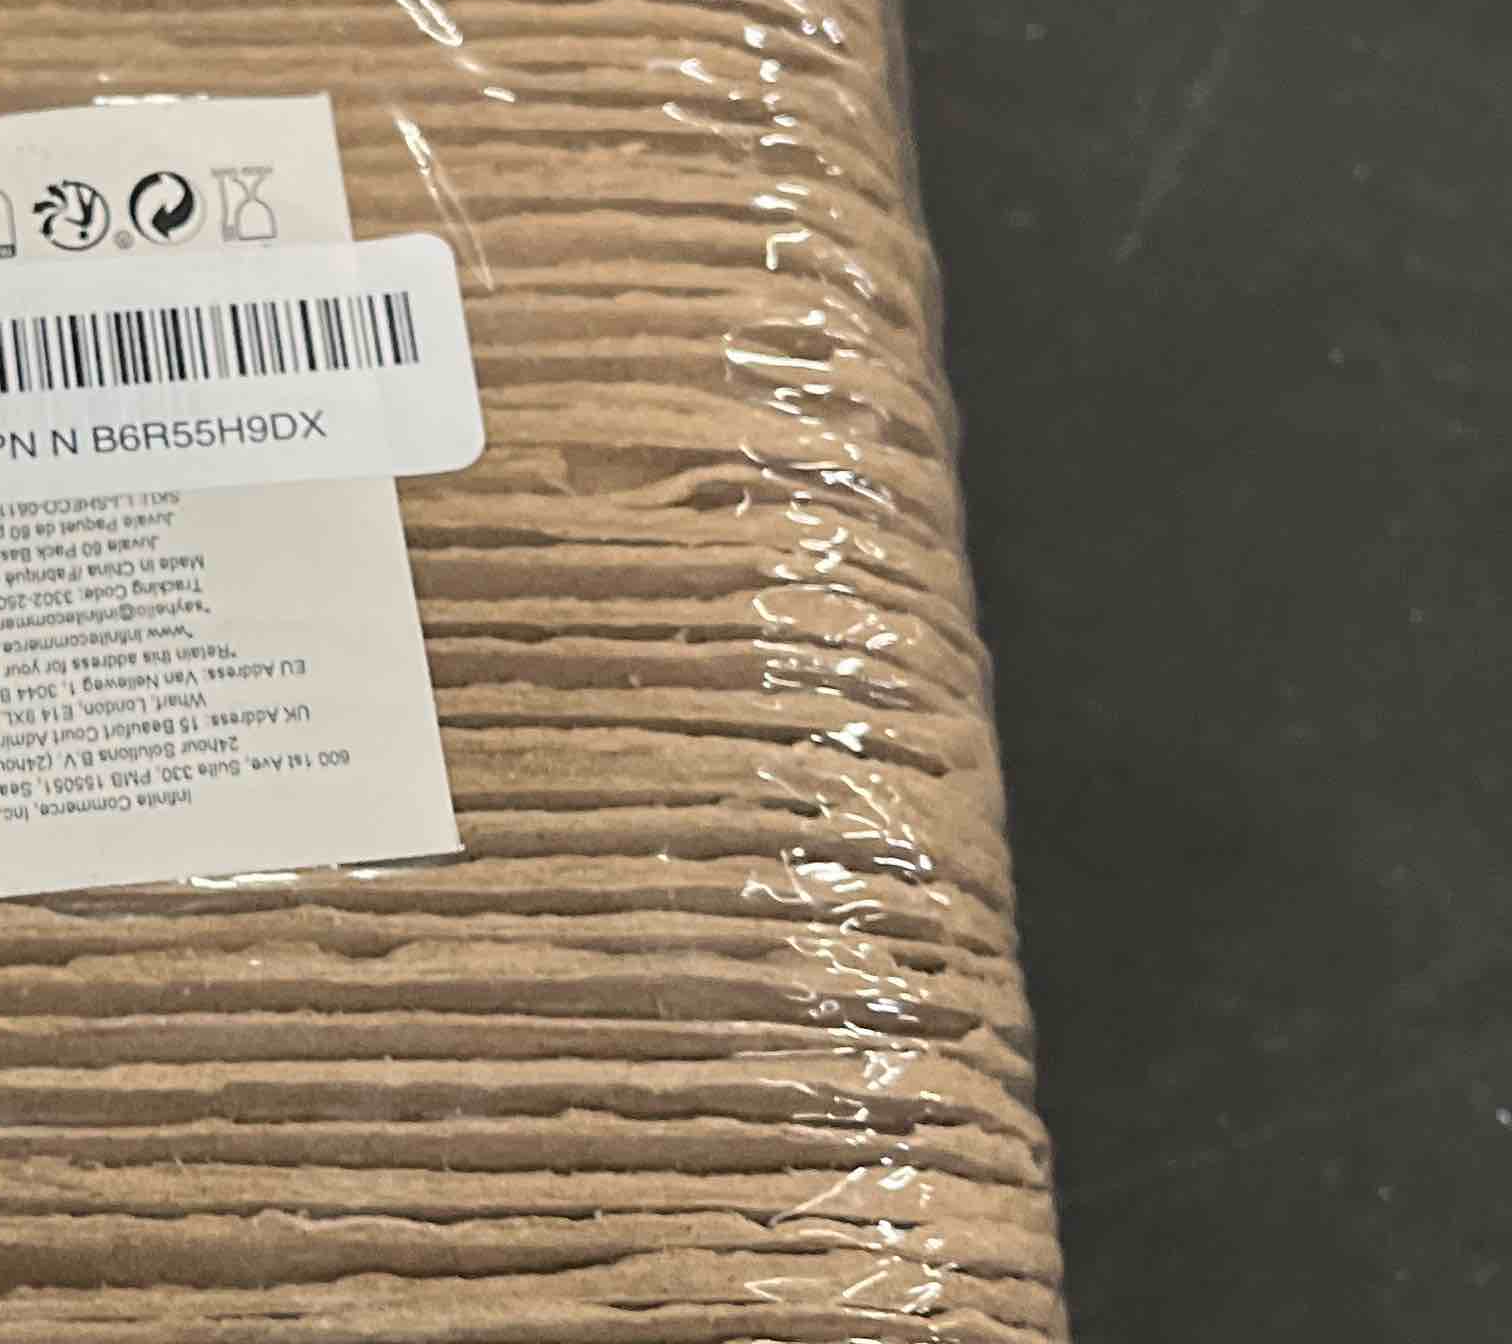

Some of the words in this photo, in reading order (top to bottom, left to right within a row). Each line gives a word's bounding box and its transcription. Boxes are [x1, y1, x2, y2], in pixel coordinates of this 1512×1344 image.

[51, 428, 79, 457] N
[91, 409, 328, 454] B6R55H9DX
[33, 519, 57, 539] de
[58, 515, 119, 537] Paquet
[121, 511, 176, 531] Juvale
[34, 541, 78, 563] Pack
[105, 533, 161, 555] Juvale
[85, 559, 136, 580] China
[138, 557, 156, 575] in
[157, 553, 206, 574] Made
[77, 583, 129, 604] Code:
[130, 574, 204, 598] Tracking
[3, 657, 41, 679] your
[44, 657, 68, 677] for
[70, 651, 138, 672] address
[141, 648, 173, 667] this
[279, 658, 307, 678] EU
[161, 668, 200, 688] Van
[201, 659, 276, 681] Address:
[15, 682, 59, 703] 3044
[60, 679, 77, 698] 1,
[81, 671, 161, 695] Nelleweg
[74, 695, 148, 718] London,
[149, 690, 208, 714] Wharf,
[40, 702, 75, 725] E14
[178, 714, 200, 735] 15
[205, 705, 280, 729] Address:
[281, 703, 311, 725] UK
[51, 724, 100, 747] Court
[101, 716, 176, 742] Beaufort
[96, 740, 177, 767] Solutions
[179, 734, 240, 756] 24hour
[57, 748, 95, 771] B.V.
[196, 759, 241, 779] Suite
[244, 753, 284, 773] Ave,
[287, 752, 313, 771] 1st
[317, 748, 351, 768] 600
[36, 773, 105, 797] 155051,
[108, 767, 153, 790] PMB
[154, 763, 194, 785] 330,
[33, 793, 133, 817] Commerce,
[135, 787, 193, 809] Infinite
